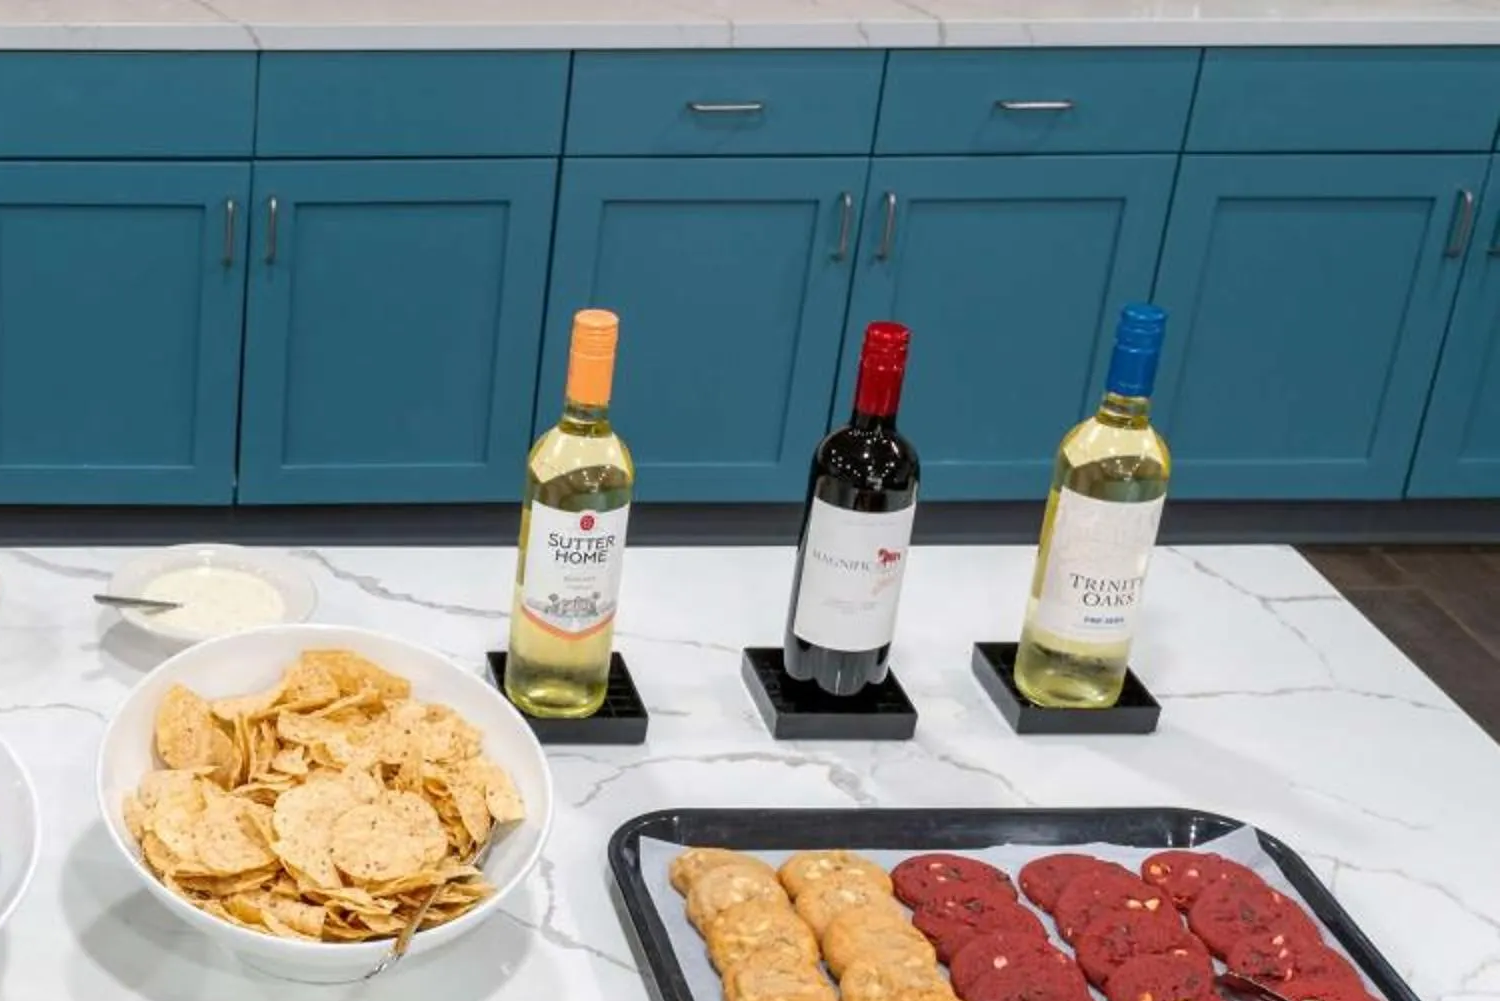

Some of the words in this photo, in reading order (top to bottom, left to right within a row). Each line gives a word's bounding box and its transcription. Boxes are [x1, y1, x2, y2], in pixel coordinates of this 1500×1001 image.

[548, 533, 616, 550] SUTTER
[555, 550, 607, 564] HOME
[1083, 592, 1135, 607] OAKS
